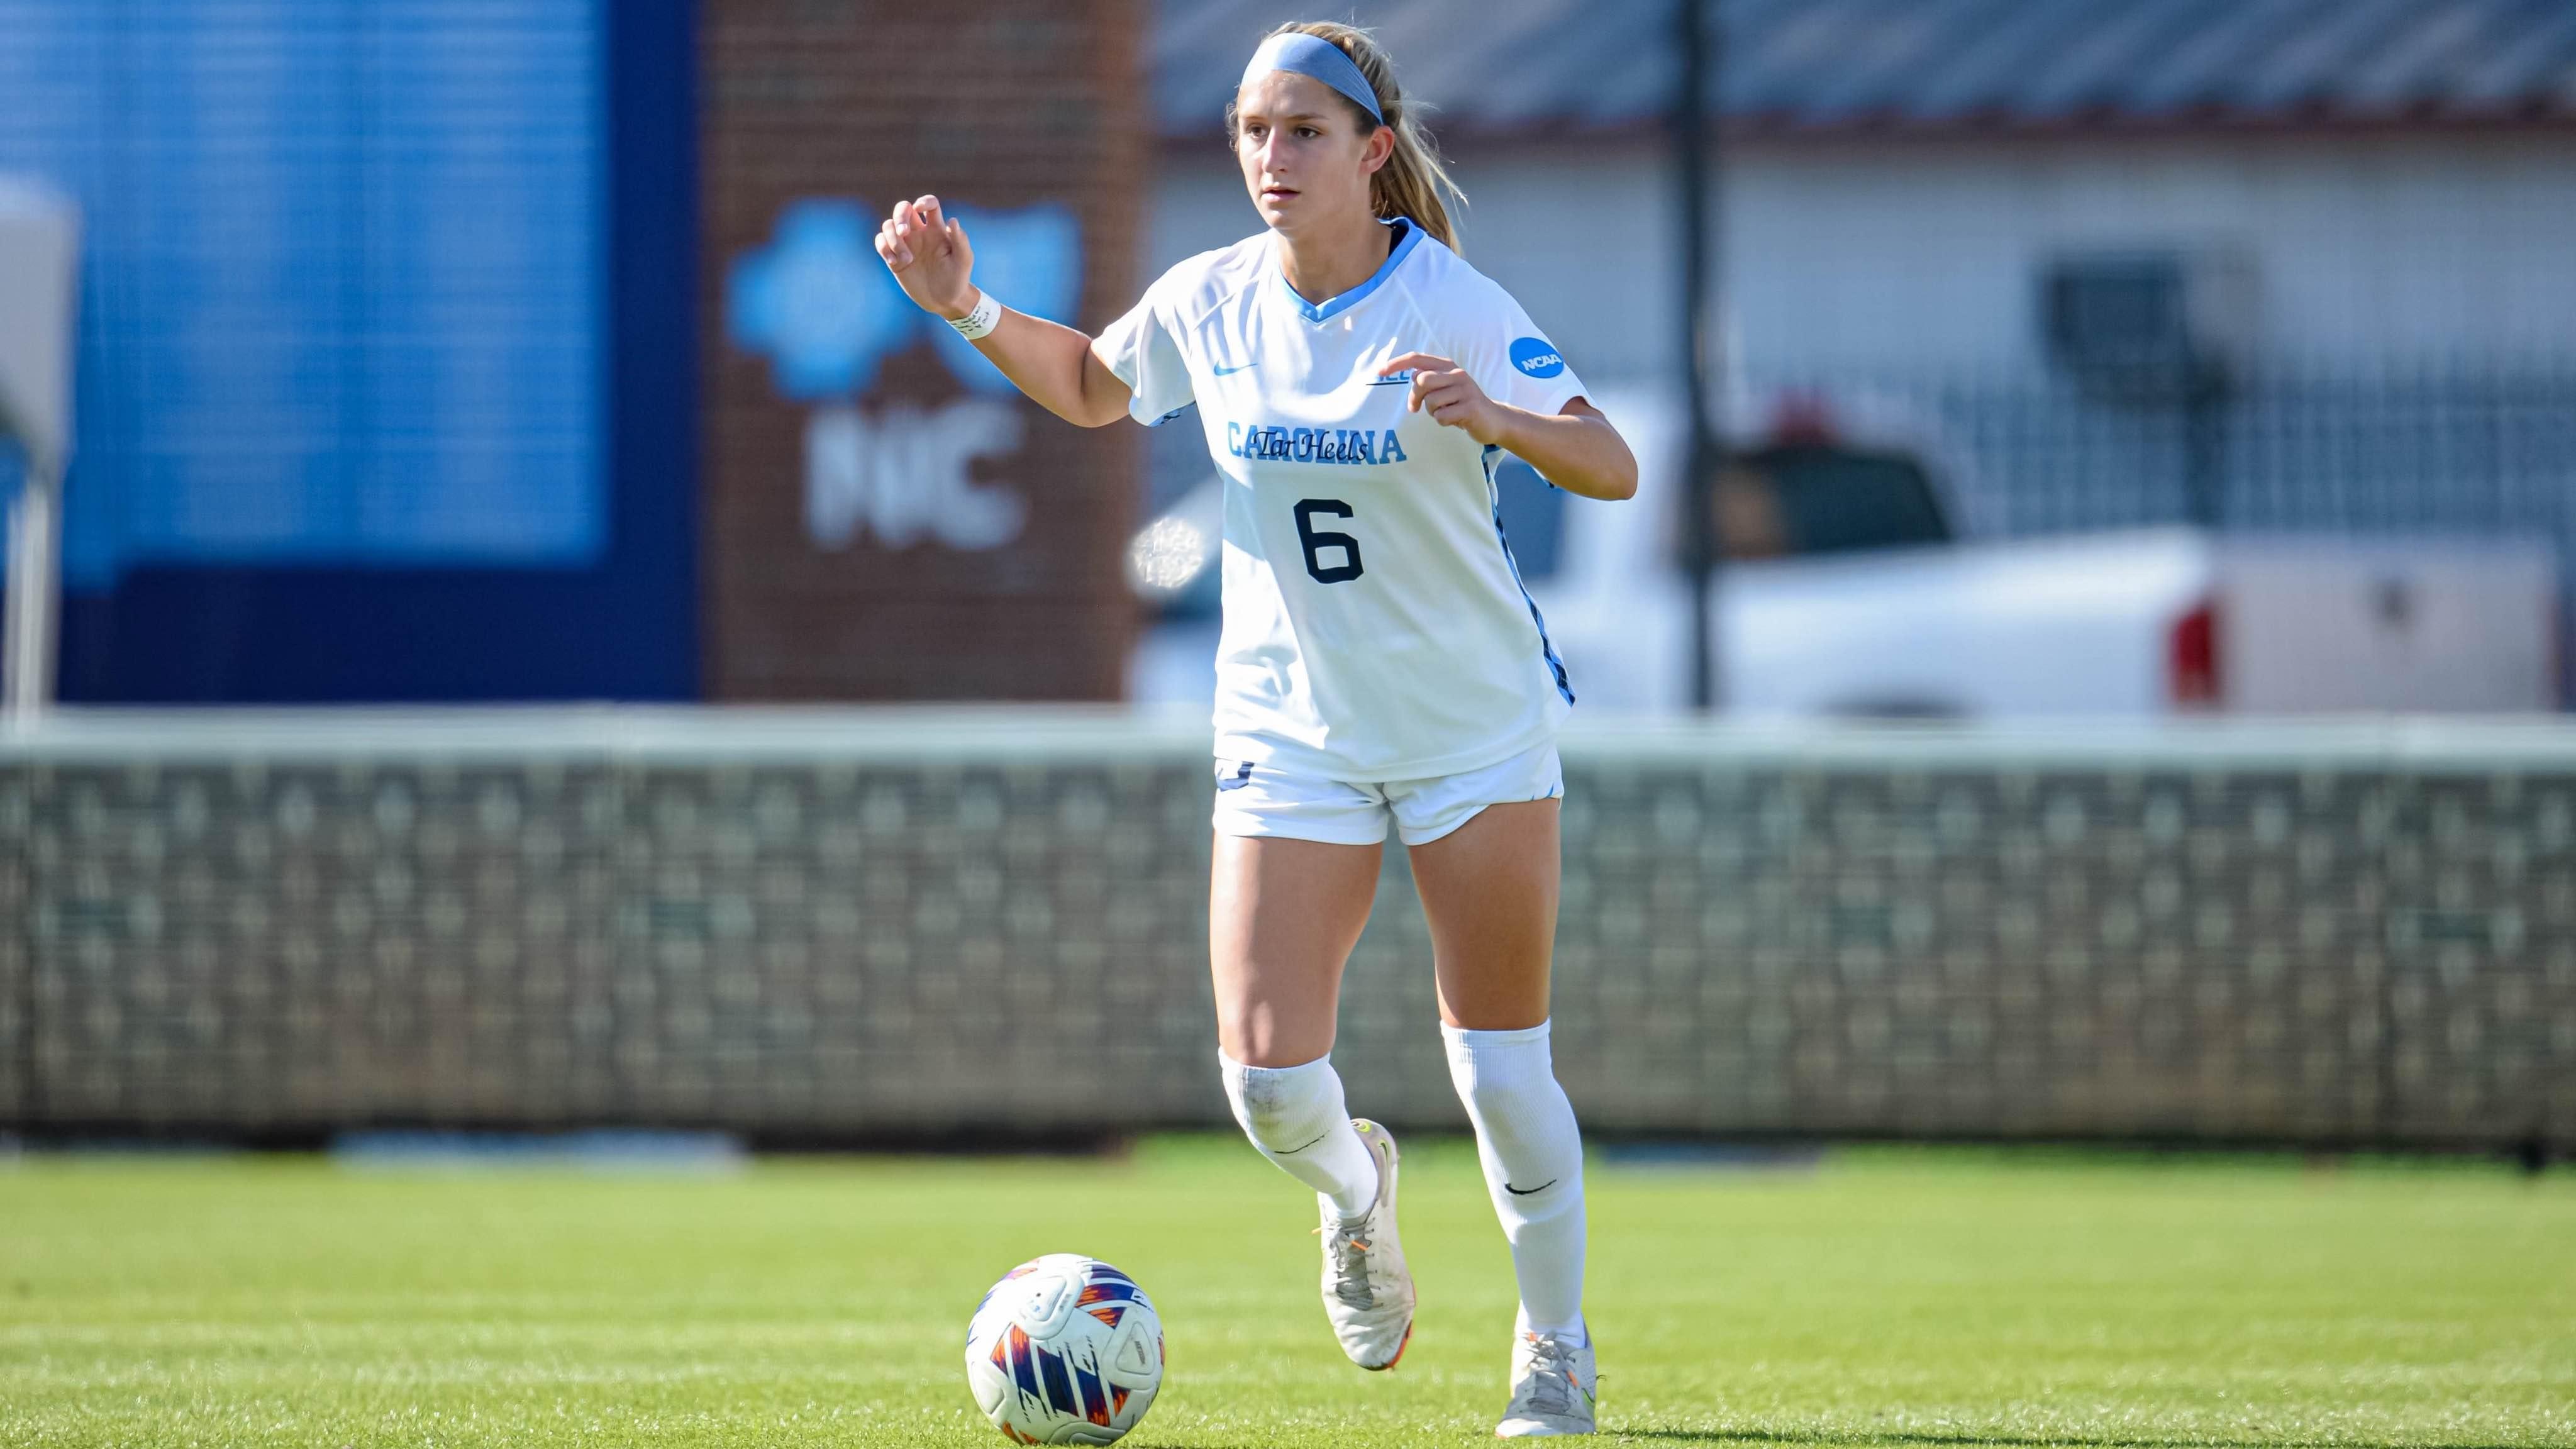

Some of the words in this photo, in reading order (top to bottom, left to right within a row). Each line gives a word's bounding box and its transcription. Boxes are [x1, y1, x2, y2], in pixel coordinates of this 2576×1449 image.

[1521, 353, 1563, 372] NCAA
[1228, 421, 1407, 465] CAROLINA
[1253, 430, 1296, 457] Tar
[1298, 430, 1368, 461] Heels
[806, 402, 1025, 548] NC
[1292, 498, 1365, 584] 6
